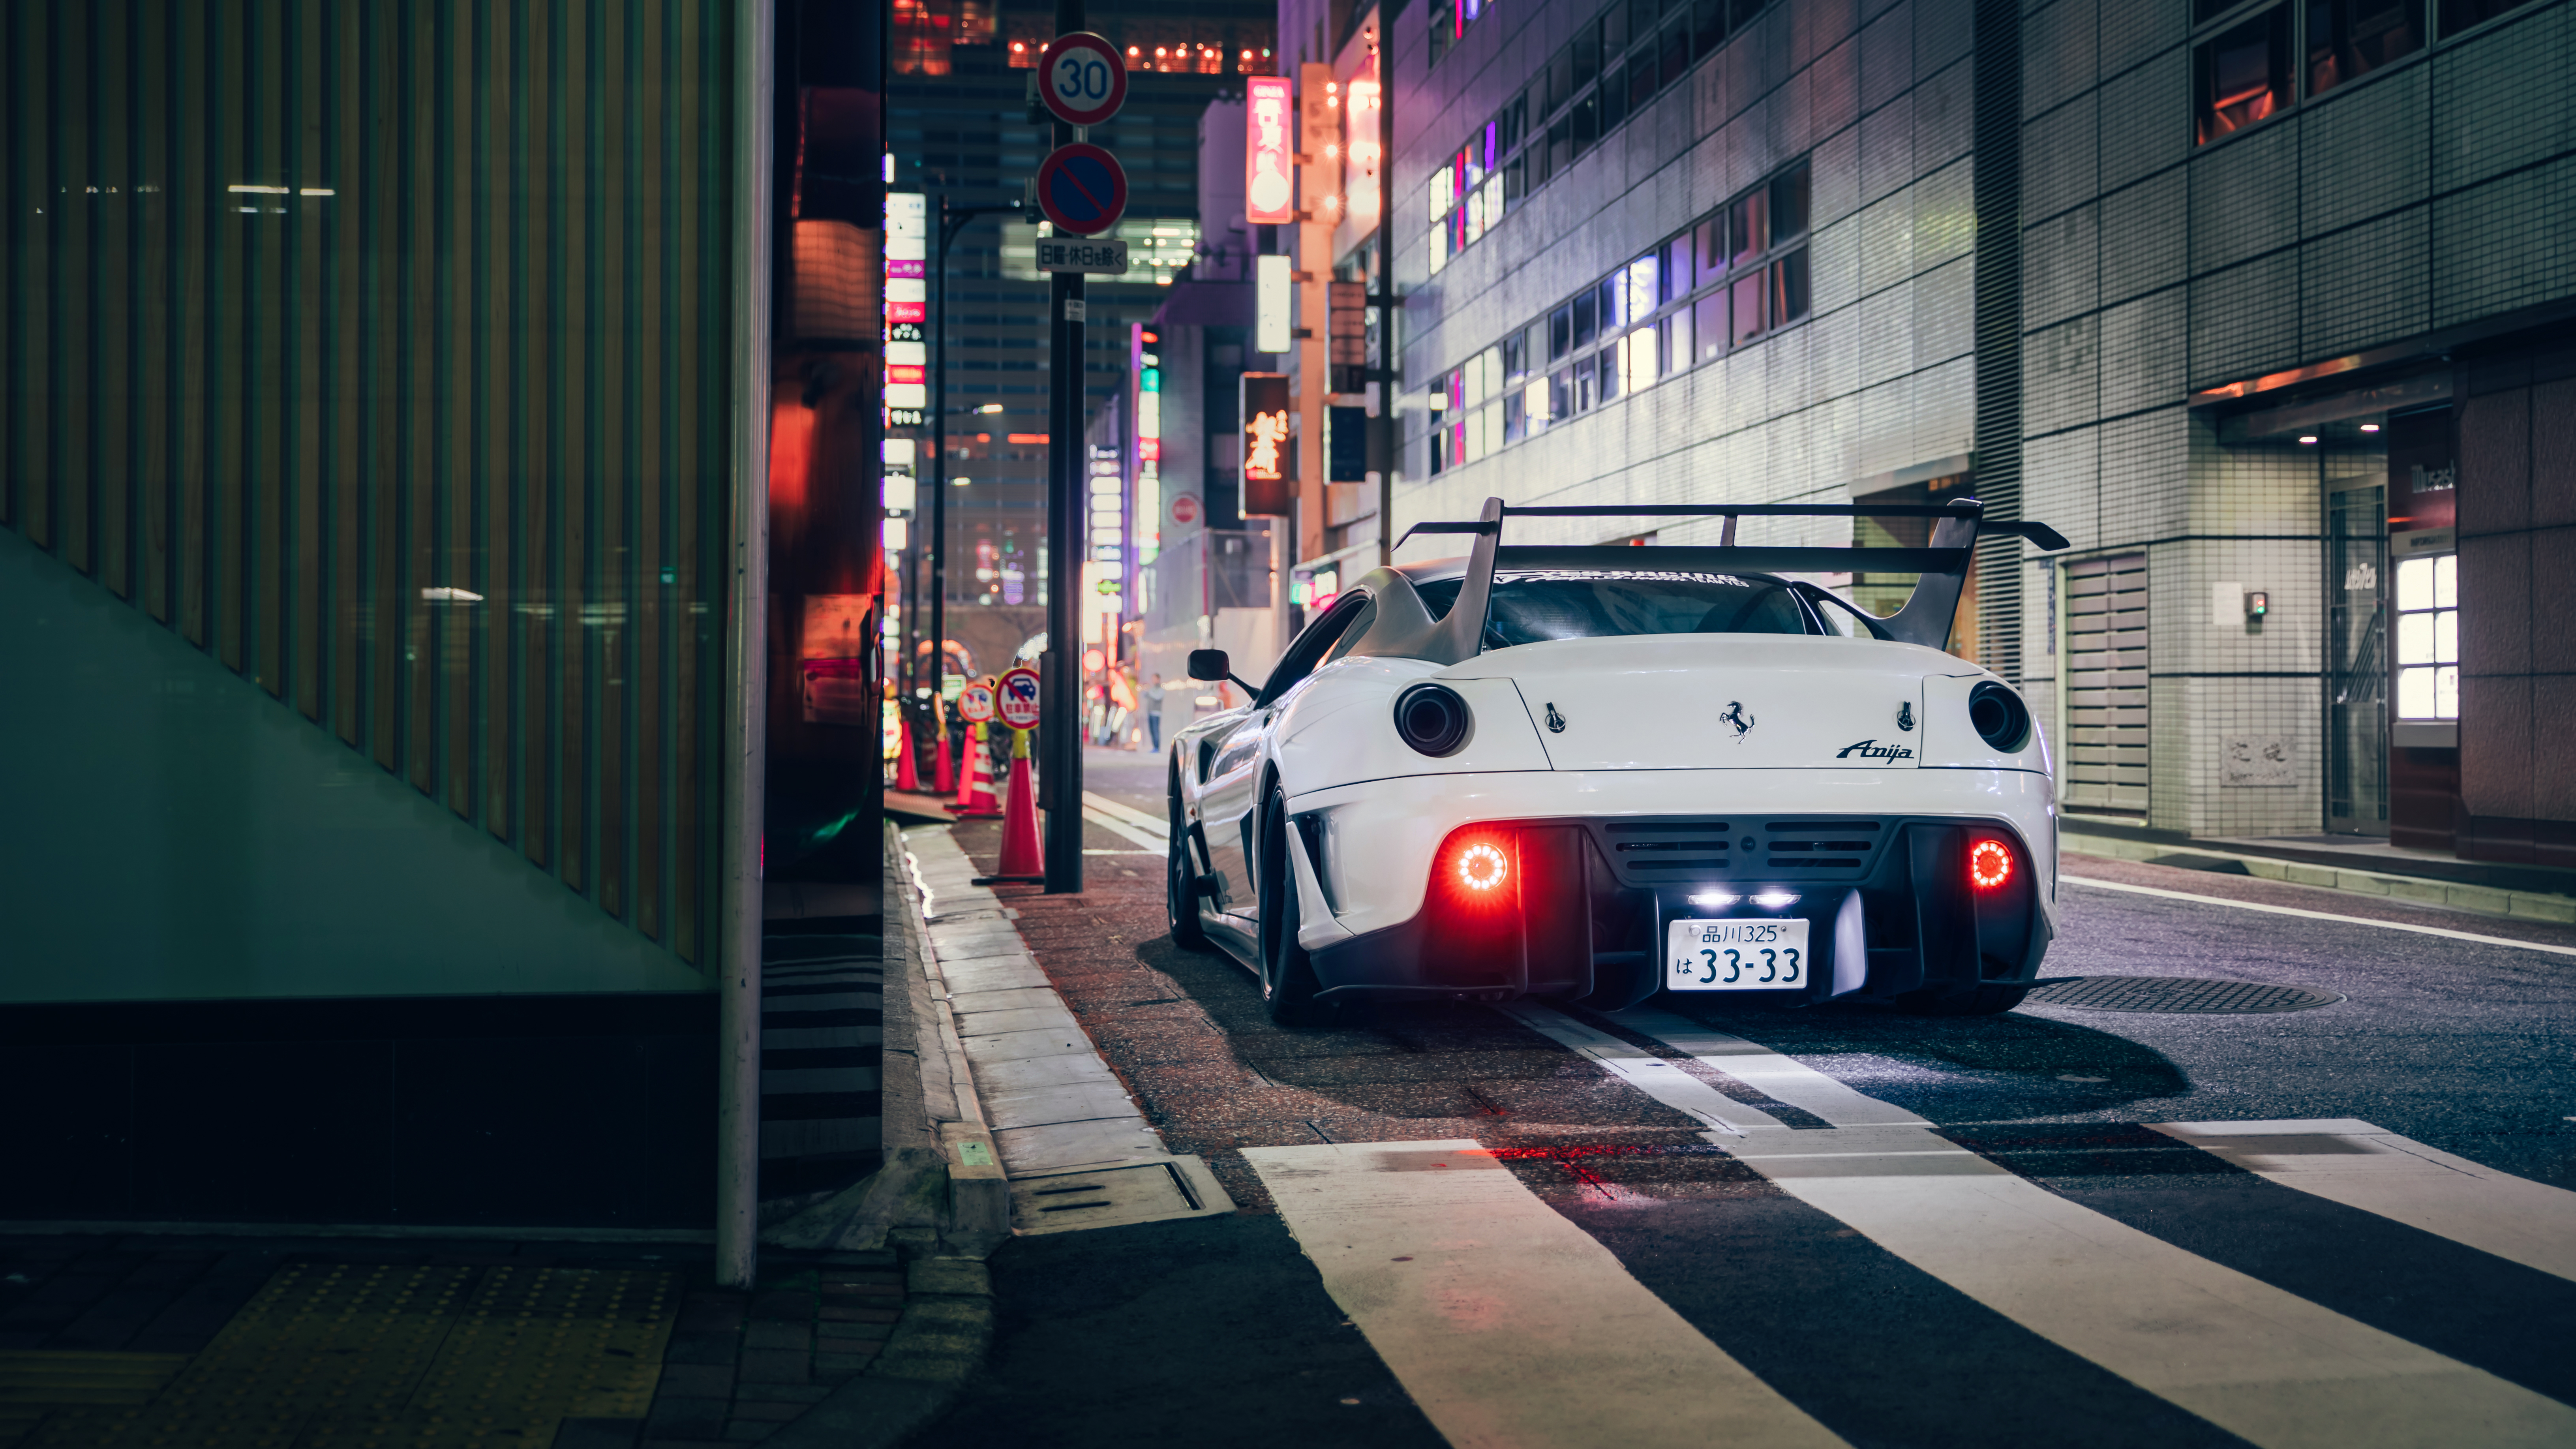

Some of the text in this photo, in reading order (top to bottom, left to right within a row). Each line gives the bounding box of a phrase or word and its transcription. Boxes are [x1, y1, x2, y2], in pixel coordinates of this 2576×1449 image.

[1059, 58, 1107, 100] 30
[1836, 740, 1914, 765] Anija
[1676, 947, 1800, 984] は 33-33
